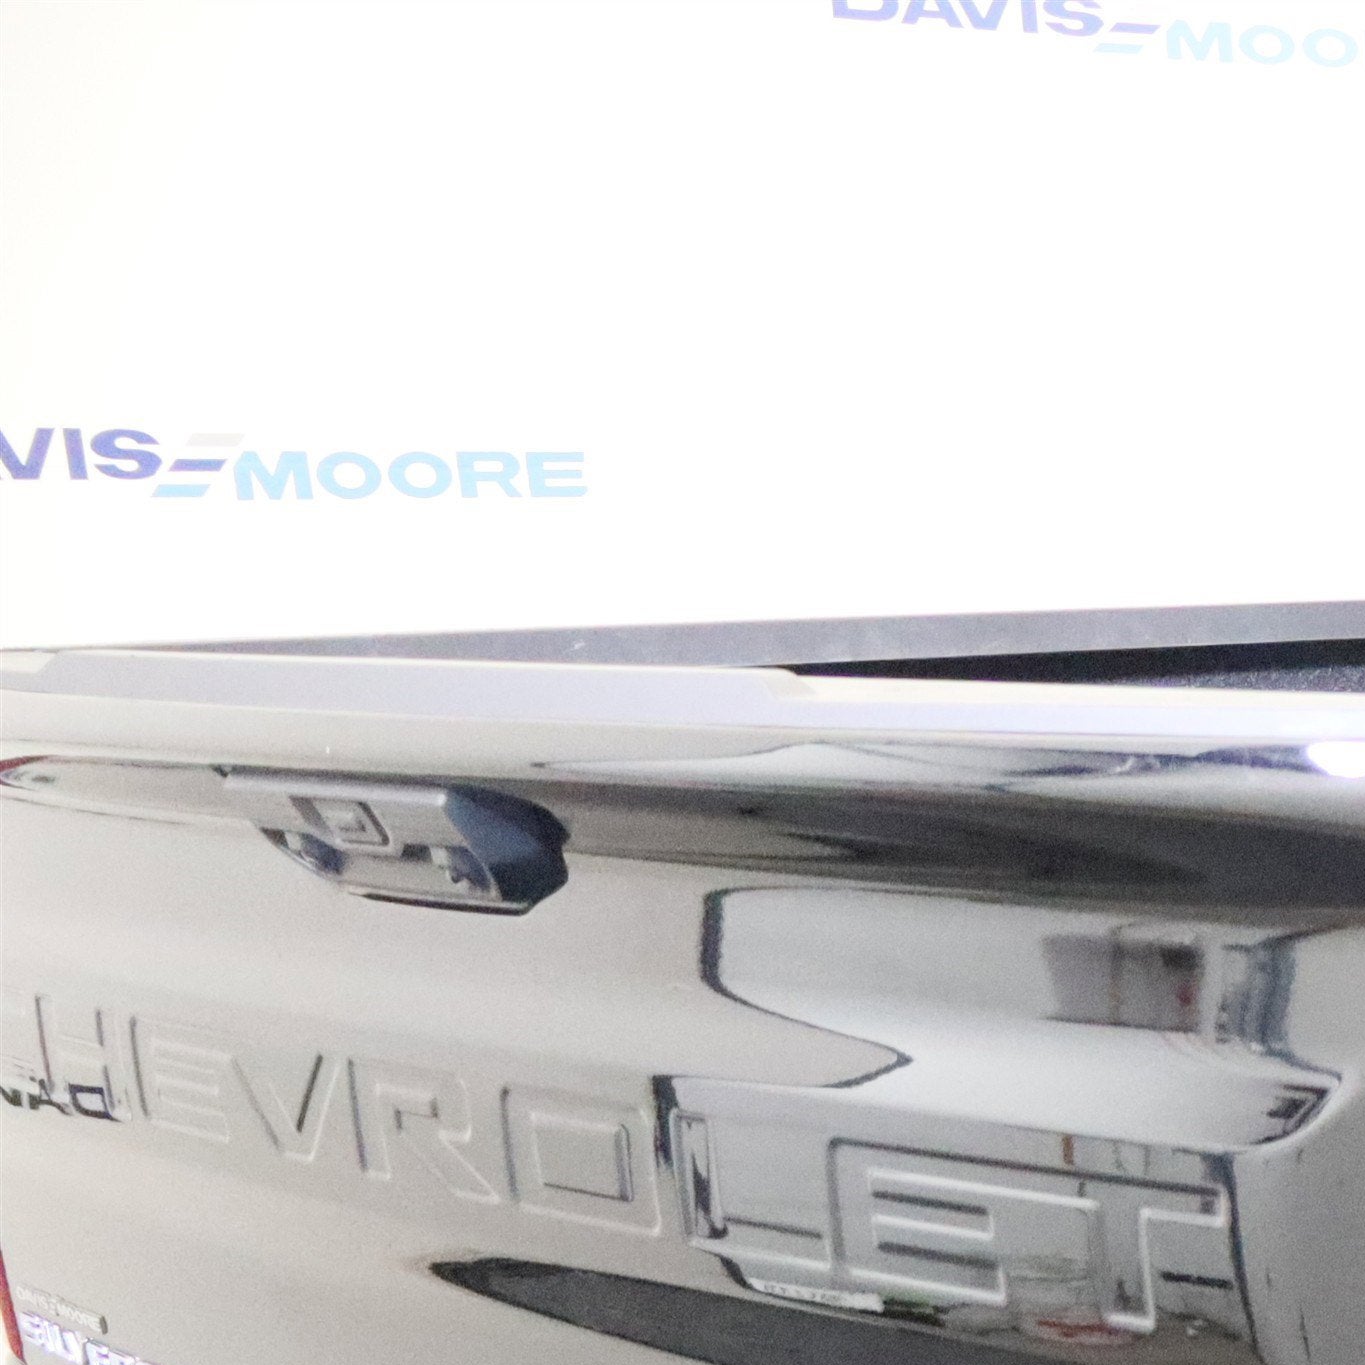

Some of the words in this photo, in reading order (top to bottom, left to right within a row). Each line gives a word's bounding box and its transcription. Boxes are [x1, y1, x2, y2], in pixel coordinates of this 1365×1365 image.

[0, 427, 162, 481] VIS
[232, 450, 589, 500] MOORE
[0, 985, 1228, 1335] HEVROLET
